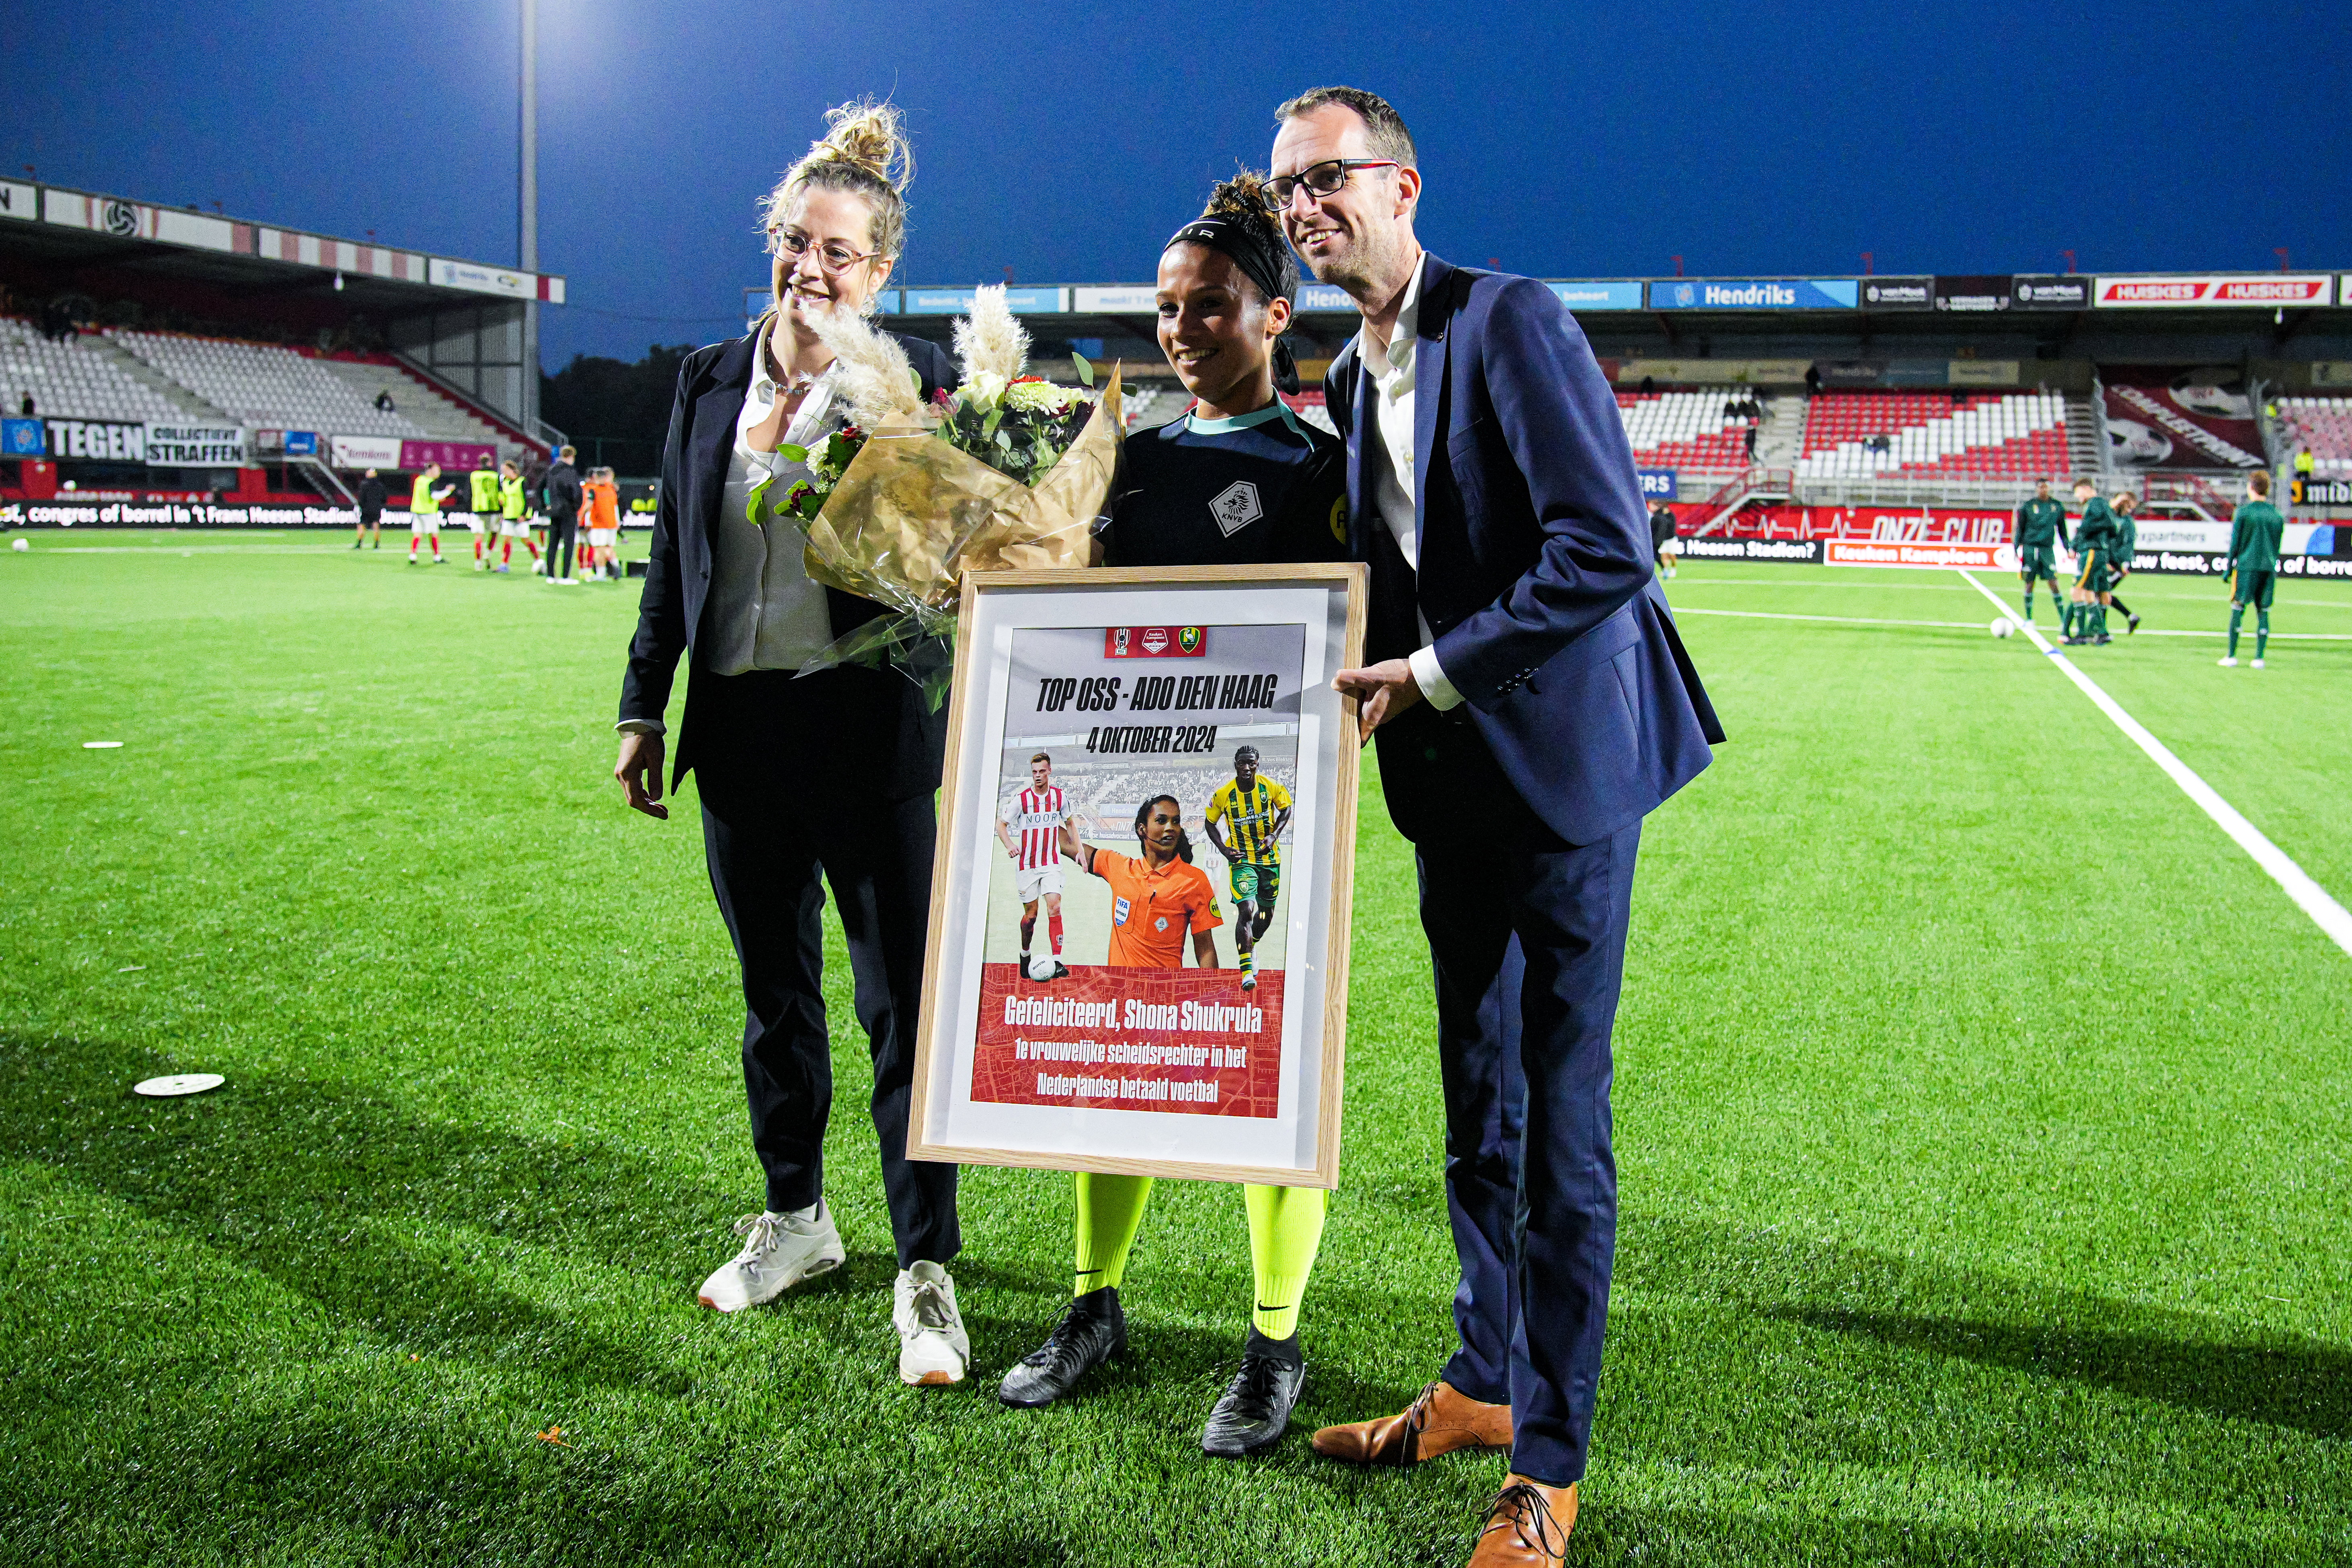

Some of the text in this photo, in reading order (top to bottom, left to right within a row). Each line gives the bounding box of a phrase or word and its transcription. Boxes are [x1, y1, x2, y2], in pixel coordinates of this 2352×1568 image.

[1232, 190, 1249, 206] NIKE
[1705, 285, 1795, 305] Hendriks
[47, 421, 145, 460] TEGEN
[148, 444, 243, 462] STRAFFEN
[28, 506, 99, 526] congres
[100, 503, 121, 523] of
[121, 503, 173, 523] borrel
[173, 504, 191, 523] in
[206, 506, 249, 524] Frans
[1222, 513, 1243, 523] KNVB
[1943, 517, 2005, 543] CLUB
[1746, 541, 1816, 559] Stadion?
[1834, 545, 1988, 565] Keuken Kampioen
[2160, 551, 2209, 573] feest,
[2284, 556, 2305, 574] of
[1036, 678, 1077, 712] TOP
[1076, 677, 1121, 711] OSS
[1129, 676, 1176, 711] ADO
[1174, 675, 1220, 710] DEN
[1218, 674, 1278, 709] HAAG
[1086, 725, 1218, 753] 4 OKTOBER 2024
[1026, 813, 1057, 824] NOOR
[1117, 898, 1128, 909] FIFA
[1004, 995, 1262, 1033] Gefeliciteerd, Shona Shukrula
[1015, 1037, 1247, 1068] 1e vrouwelijke scheidsrechter in het
[1037, 1073, 1218, 1103] Nederlandse betaald voetbal
